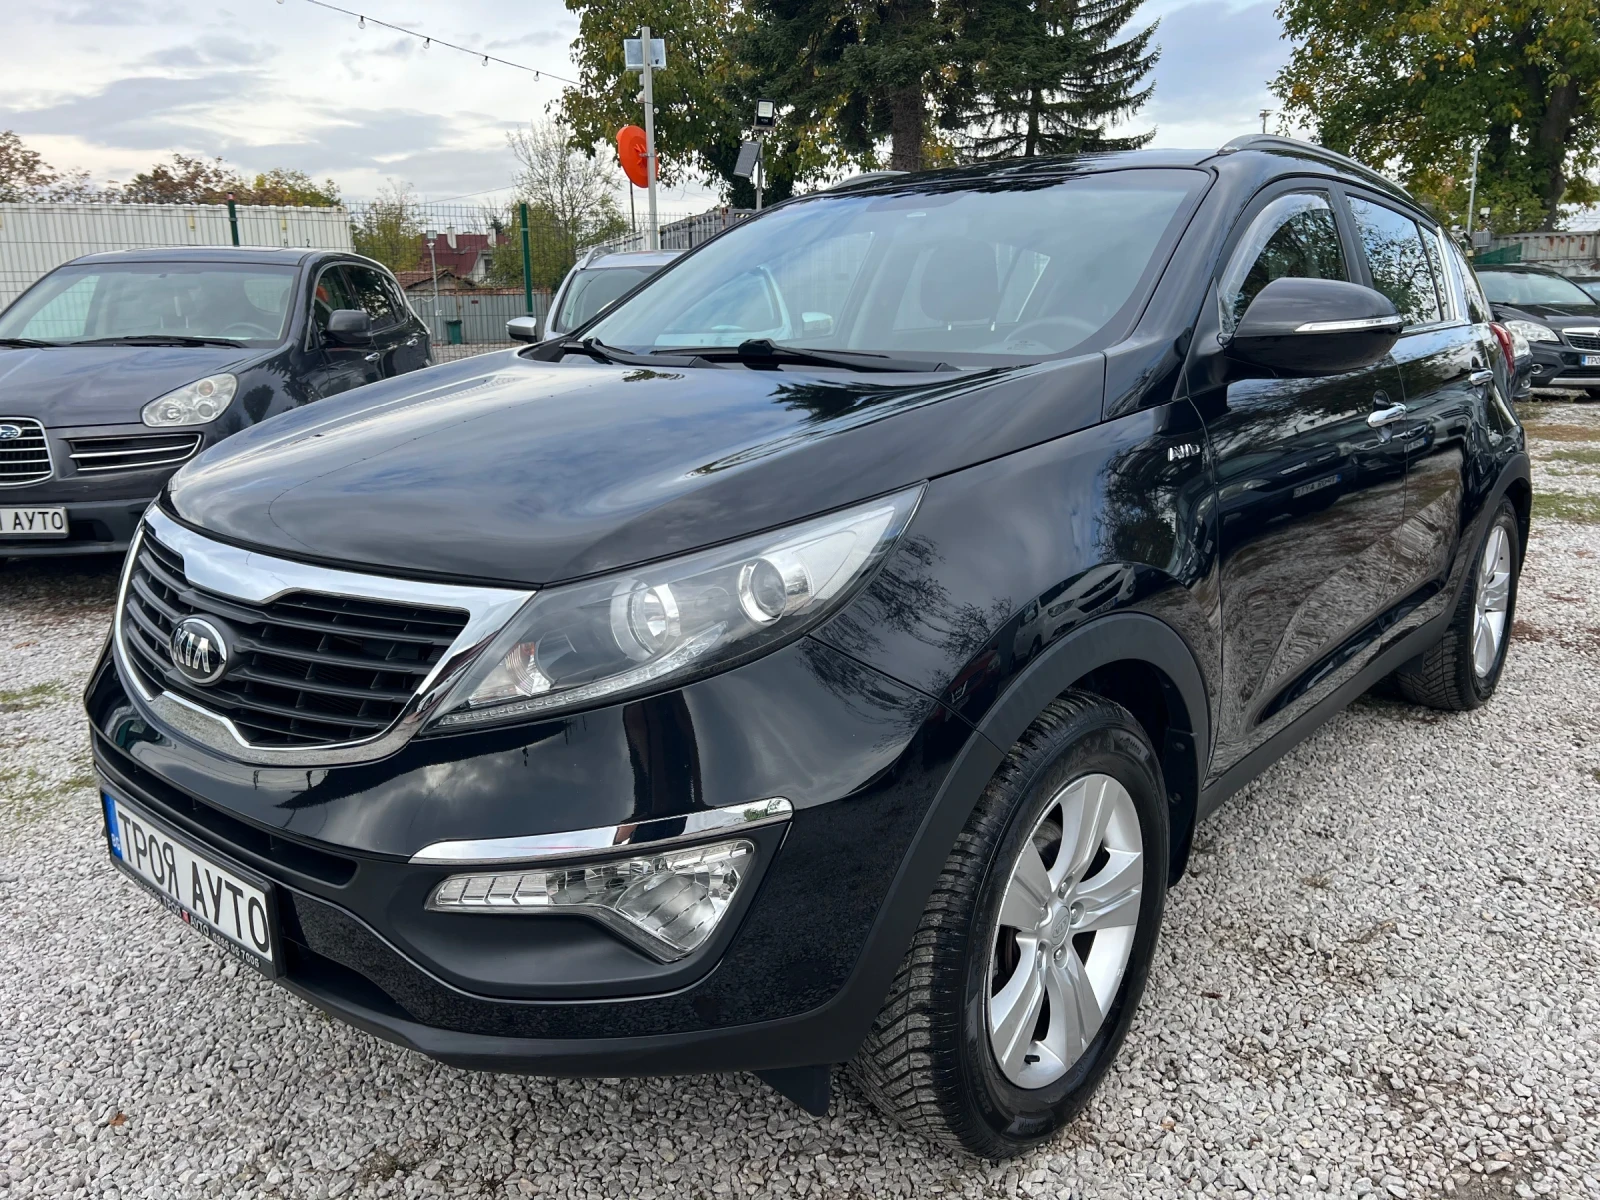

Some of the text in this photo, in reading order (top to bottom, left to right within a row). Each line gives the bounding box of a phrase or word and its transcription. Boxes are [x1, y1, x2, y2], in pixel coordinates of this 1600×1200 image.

[1168, 443, 1200, 461] AWD
[13, 512, 63, 530] АУТО
[174, 628, 211, 673] KIA
[111, 833, 121, 850] BG
[118, 810, 180, 900] ТРОЯ
[192, 860, 270, 953] АУТО
